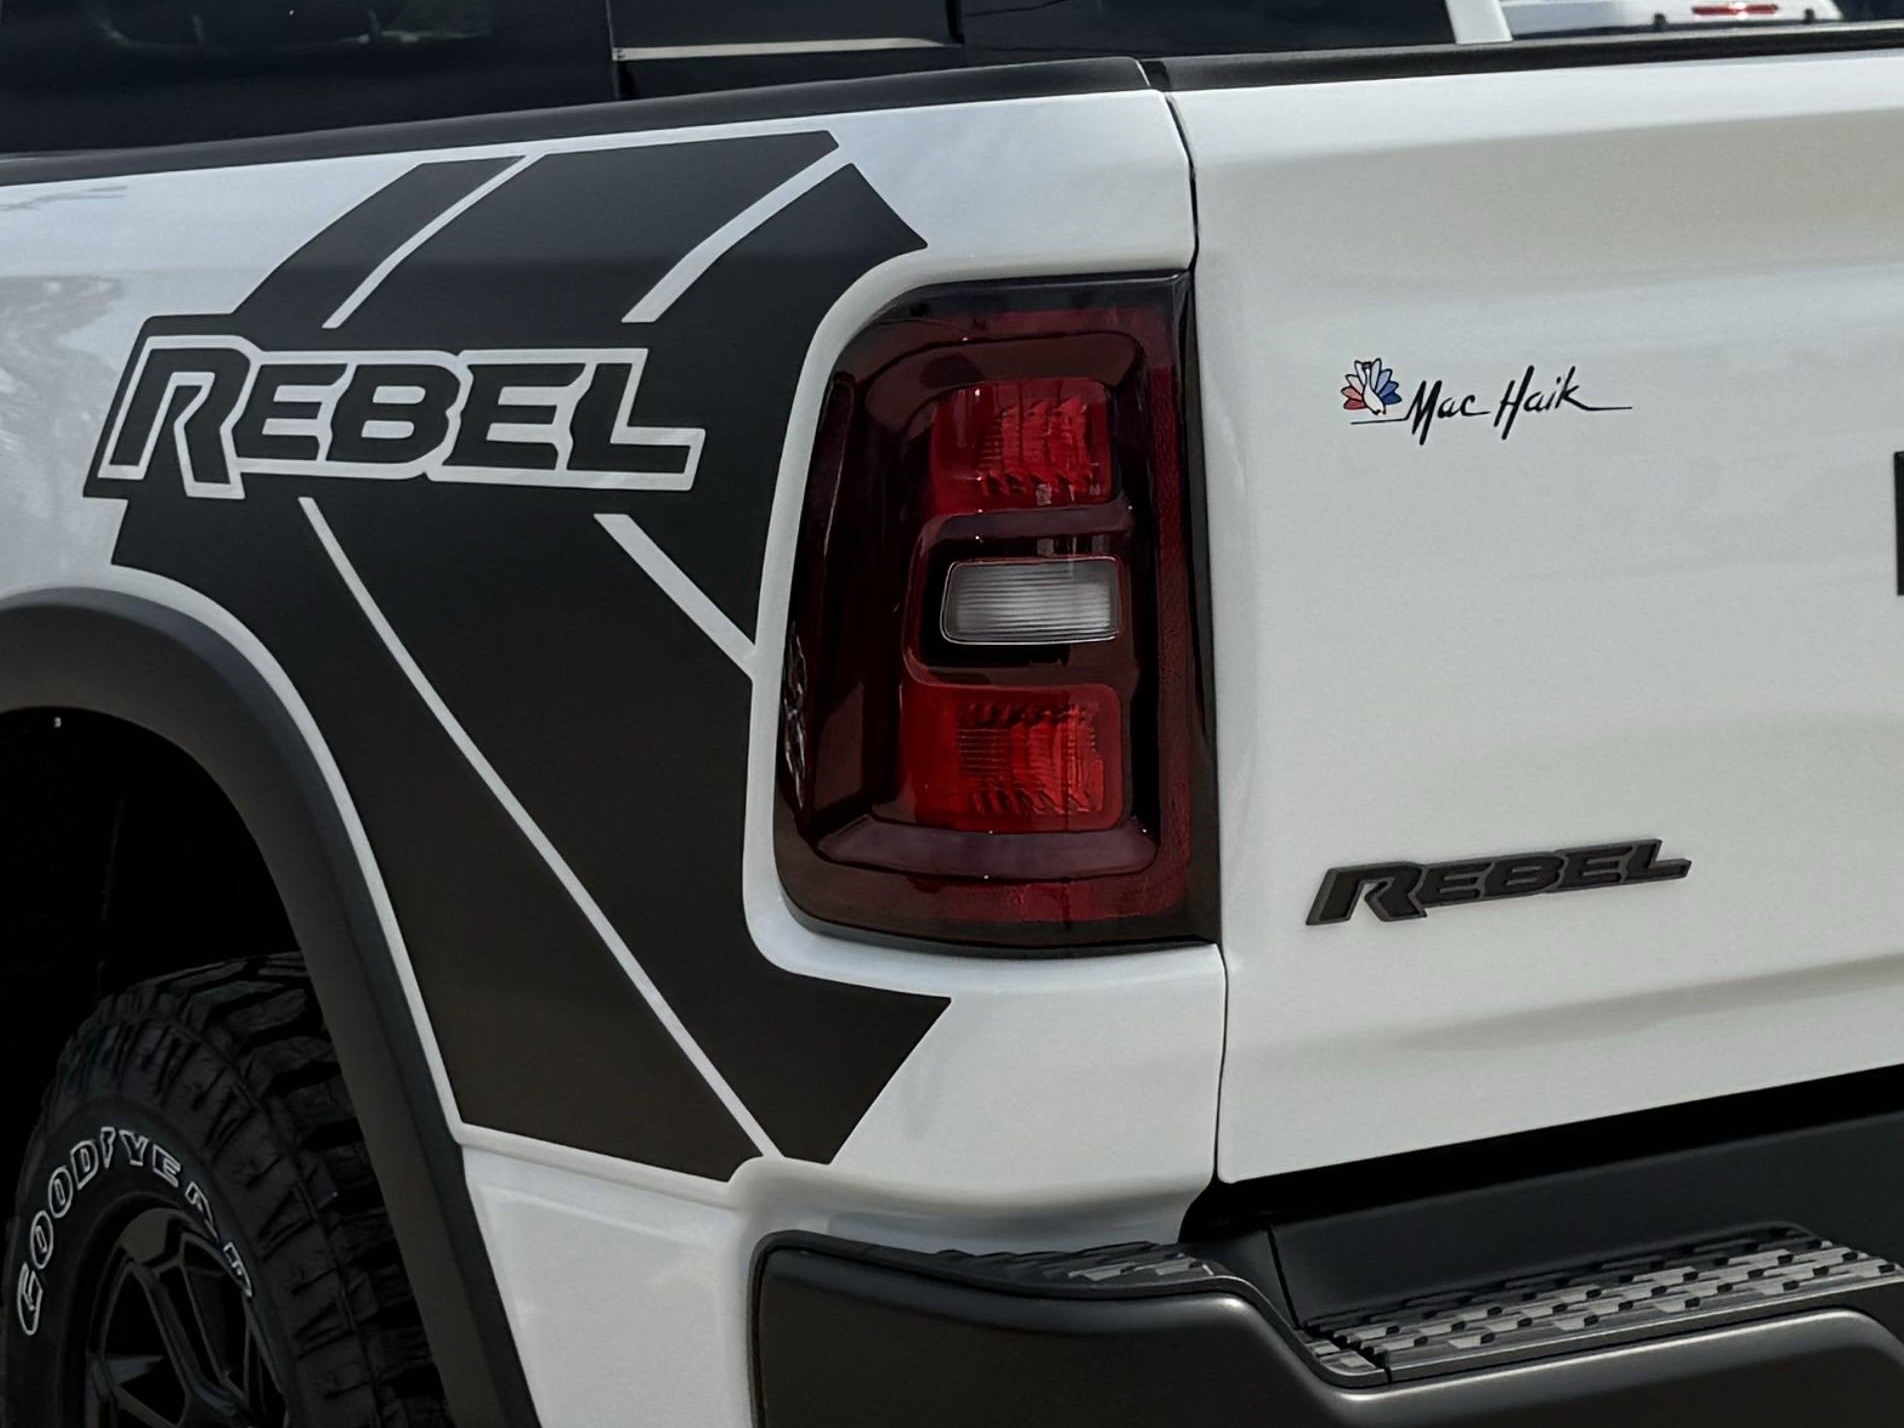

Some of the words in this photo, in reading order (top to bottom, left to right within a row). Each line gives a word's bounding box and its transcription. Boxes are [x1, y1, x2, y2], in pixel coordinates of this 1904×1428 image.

[97, 334, 707, 500] REBEL
[1351, 379, 1489, 446] Mac
[1493, 365, 1633, 440] Haik
[1304, 838, 1692, 926] REBEL
[16, 1125, 254, 1336] GOODYEAR
